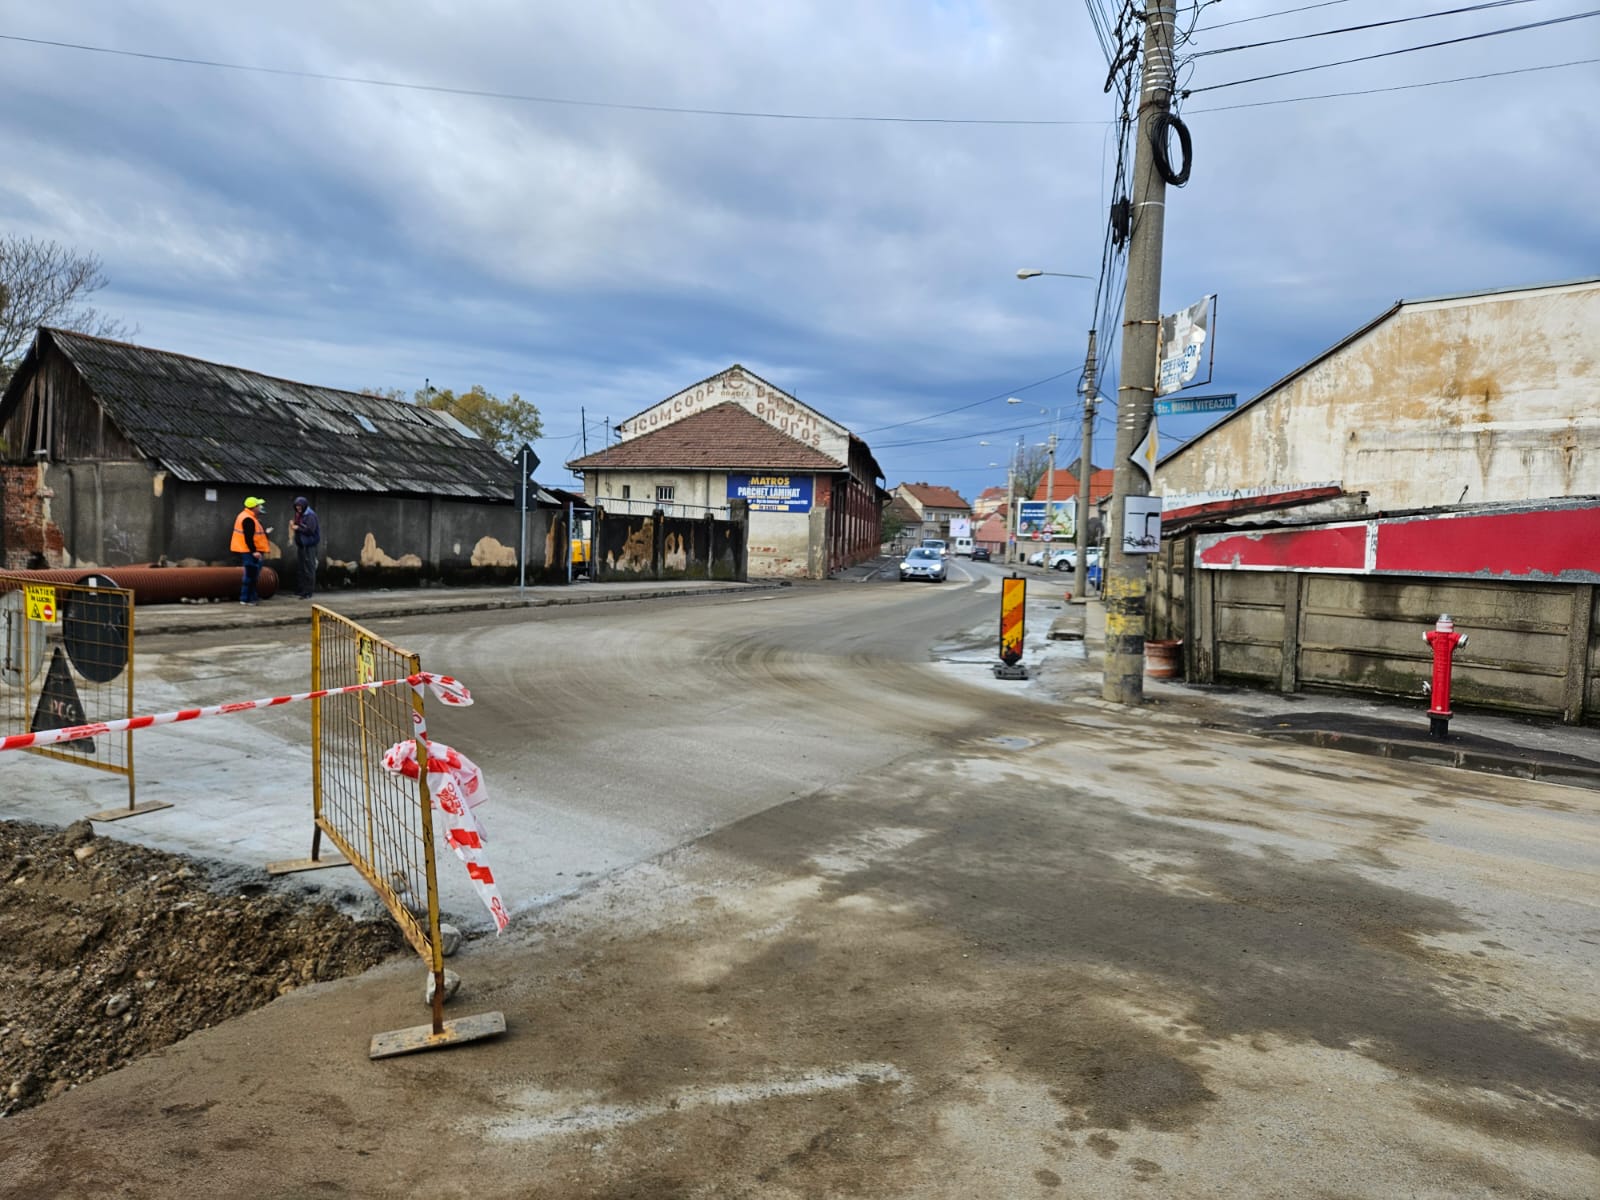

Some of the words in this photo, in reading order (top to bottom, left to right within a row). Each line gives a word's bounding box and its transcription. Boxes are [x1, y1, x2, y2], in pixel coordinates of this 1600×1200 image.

[634, 384, 715, 434] ICOMCOOP
[757, 385, 819, 430] DEPOZIT
[1195, 398, 1235, 411] VITEAZUL
[757, 402, 820, 446] en-gros
[737, 487, 769, 497] PARCHET
[769, 488, 800, 498] LAMINAT
[751, 476, 790, 486] MATROS
